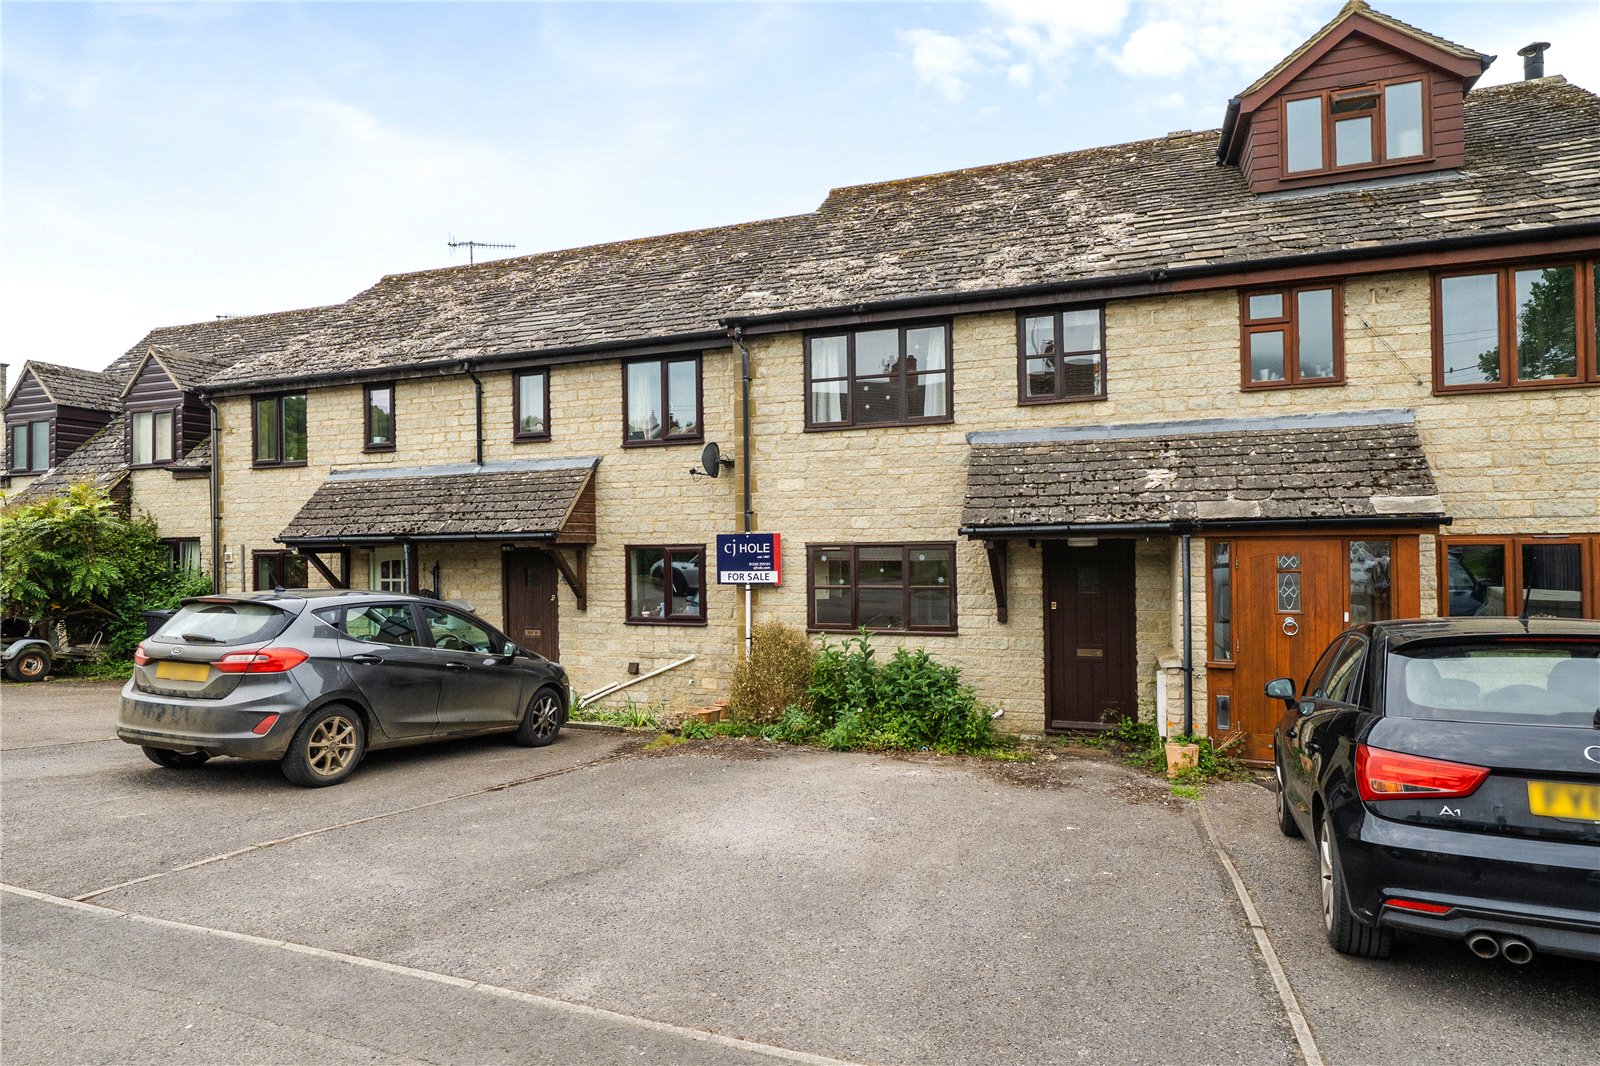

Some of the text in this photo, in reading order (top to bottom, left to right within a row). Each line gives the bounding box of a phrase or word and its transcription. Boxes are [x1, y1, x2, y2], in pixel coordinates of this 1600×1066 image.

[740, 543, 770, 553] HOLE
[727, 572, 770, 581] FOR SALE
[1439, 805, 1461, 817] A1
